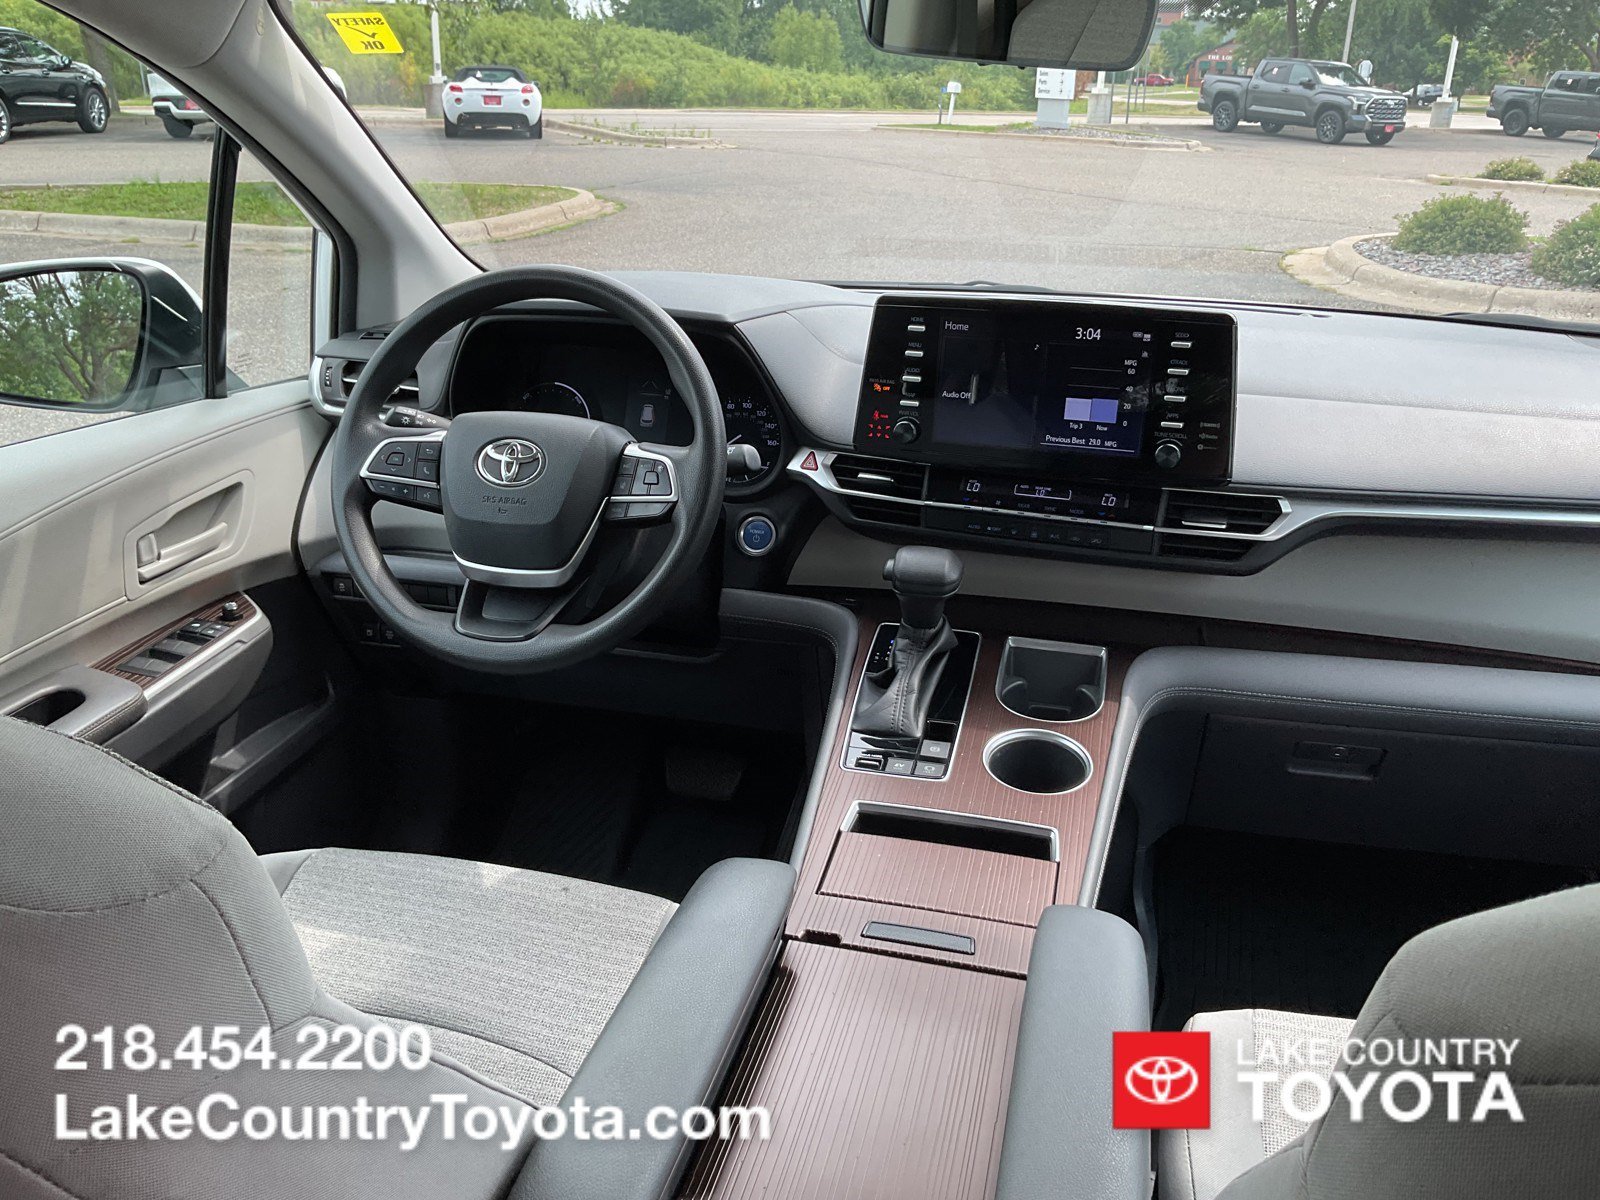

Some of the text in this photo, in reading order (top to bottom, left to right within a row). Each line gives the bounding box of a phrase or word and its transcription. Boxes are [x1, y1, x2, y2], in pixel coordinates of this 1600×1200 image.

[944, 320, 969, 331] Home
[1075, 327, 1102, 341] 3:04
[1124, 359, 1138, 367] MPG
[942, 390, 972, 399] Audio Off
[1069, 422, 1079, 430] Trip
[1045, 434, 1117, 448] Previous Best 29.0 MPG
[497, 496, 527, 505] AIRBAG
